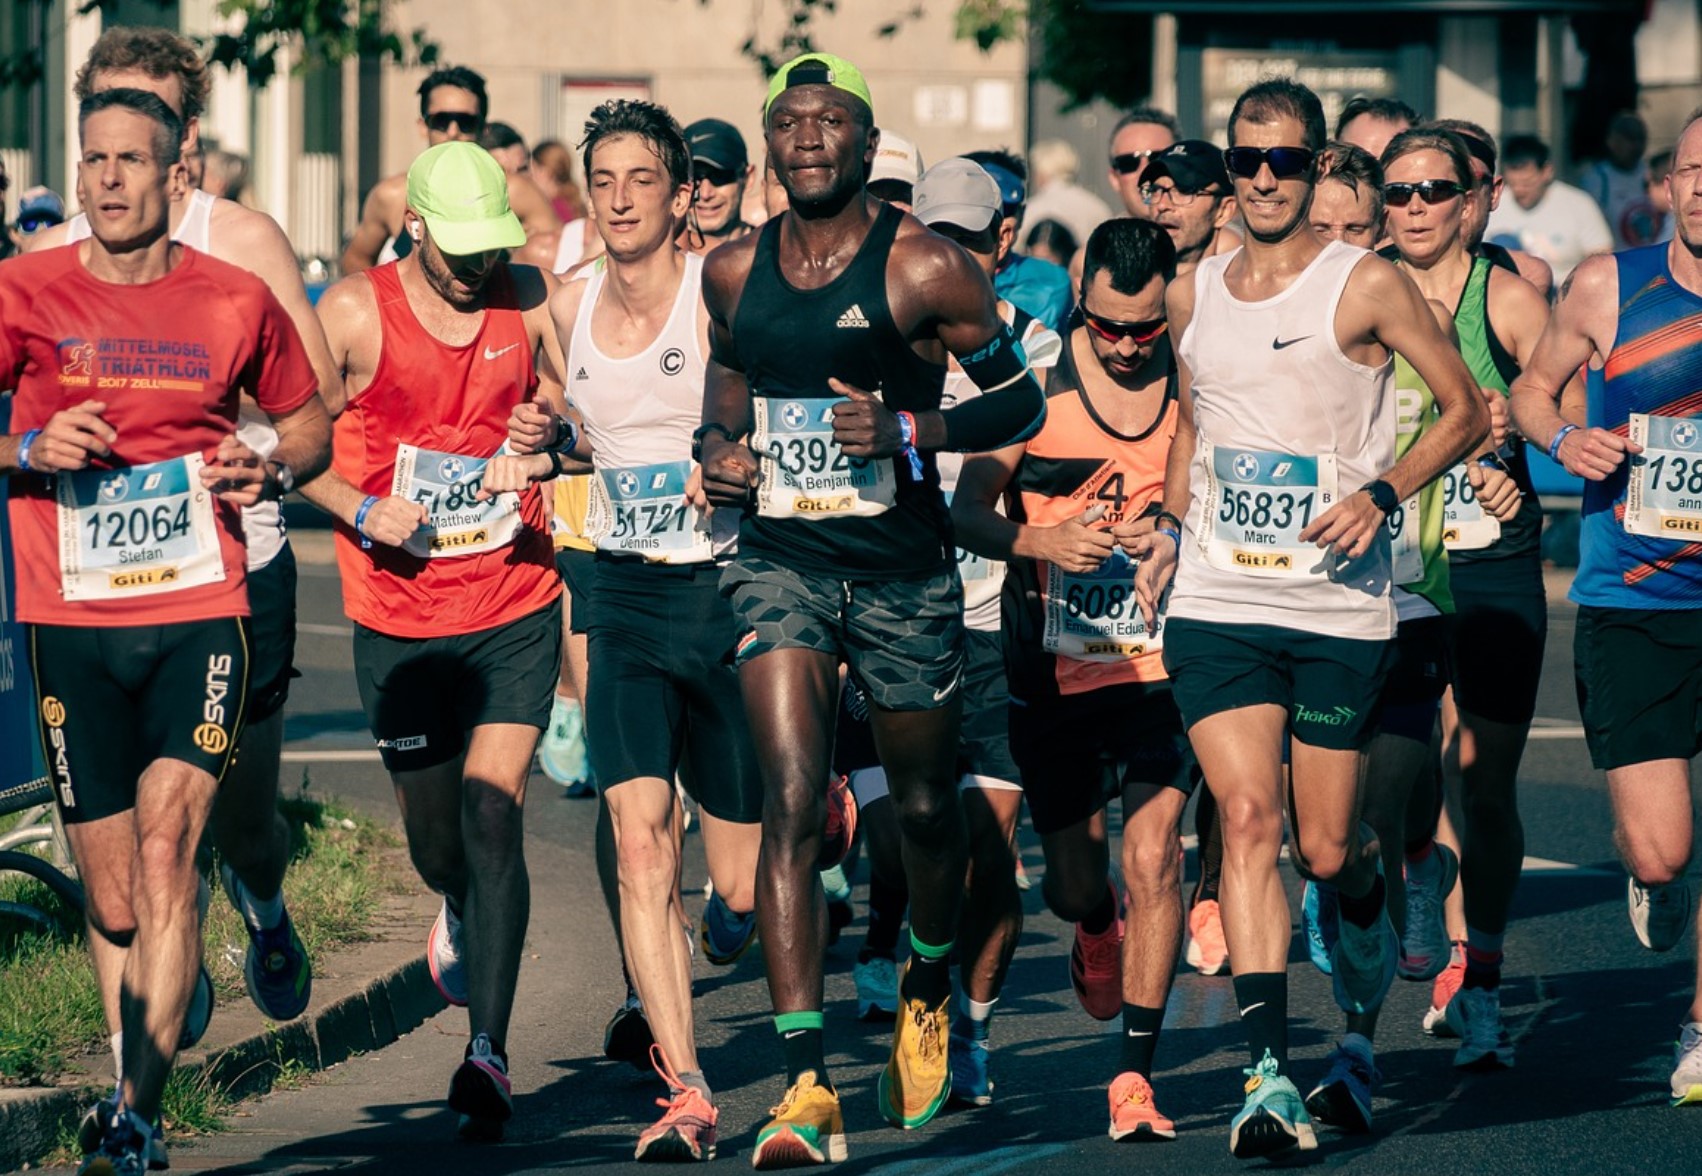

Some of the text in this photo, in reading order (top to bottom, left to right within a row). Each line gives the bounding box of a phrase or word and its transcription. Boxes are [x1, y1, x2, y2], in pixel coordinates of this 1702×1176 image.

[836, 319, 870, 329] adidas
[98, 338, 210, 358] MITTELMOSEL
[98, 356, 210, 379] TRIATHLON
[97, 377, 127, 389] 2017
[805, 473, 867, 491] Benjamin
[1649, 454, 1702, 495] 138
[195, 491, 204, 504] C
[1096, 472, 1129, 512] 4
[1322, 493, 1332, 503] B
[796, 497, 831, 511] Giti
[1219, 486, 1315, 530] 56831
[86, 498, 191, 550] 12064
[430, 512, 481, 530] Matthew
[610, 503, 689, 538] 51721
[1664, 519, 1700, 531] Giti
[431, 535, 467, 550] Giti
[1244, 530, 1277, 545] Marc
[118, 547, 163, 565] Stefan
[1236, 553, 1268, 566] Giti
[114, 573, 152, 586] Giti
[1066, 583, 1140, 620] 6087
[1065, 621, 1163, 636] Emanuel Eduao
[1087, 644, 1124, 655] Giti
[203, 653, 231, 725] SKINS
[50, 727, 77, 808] SKINS
